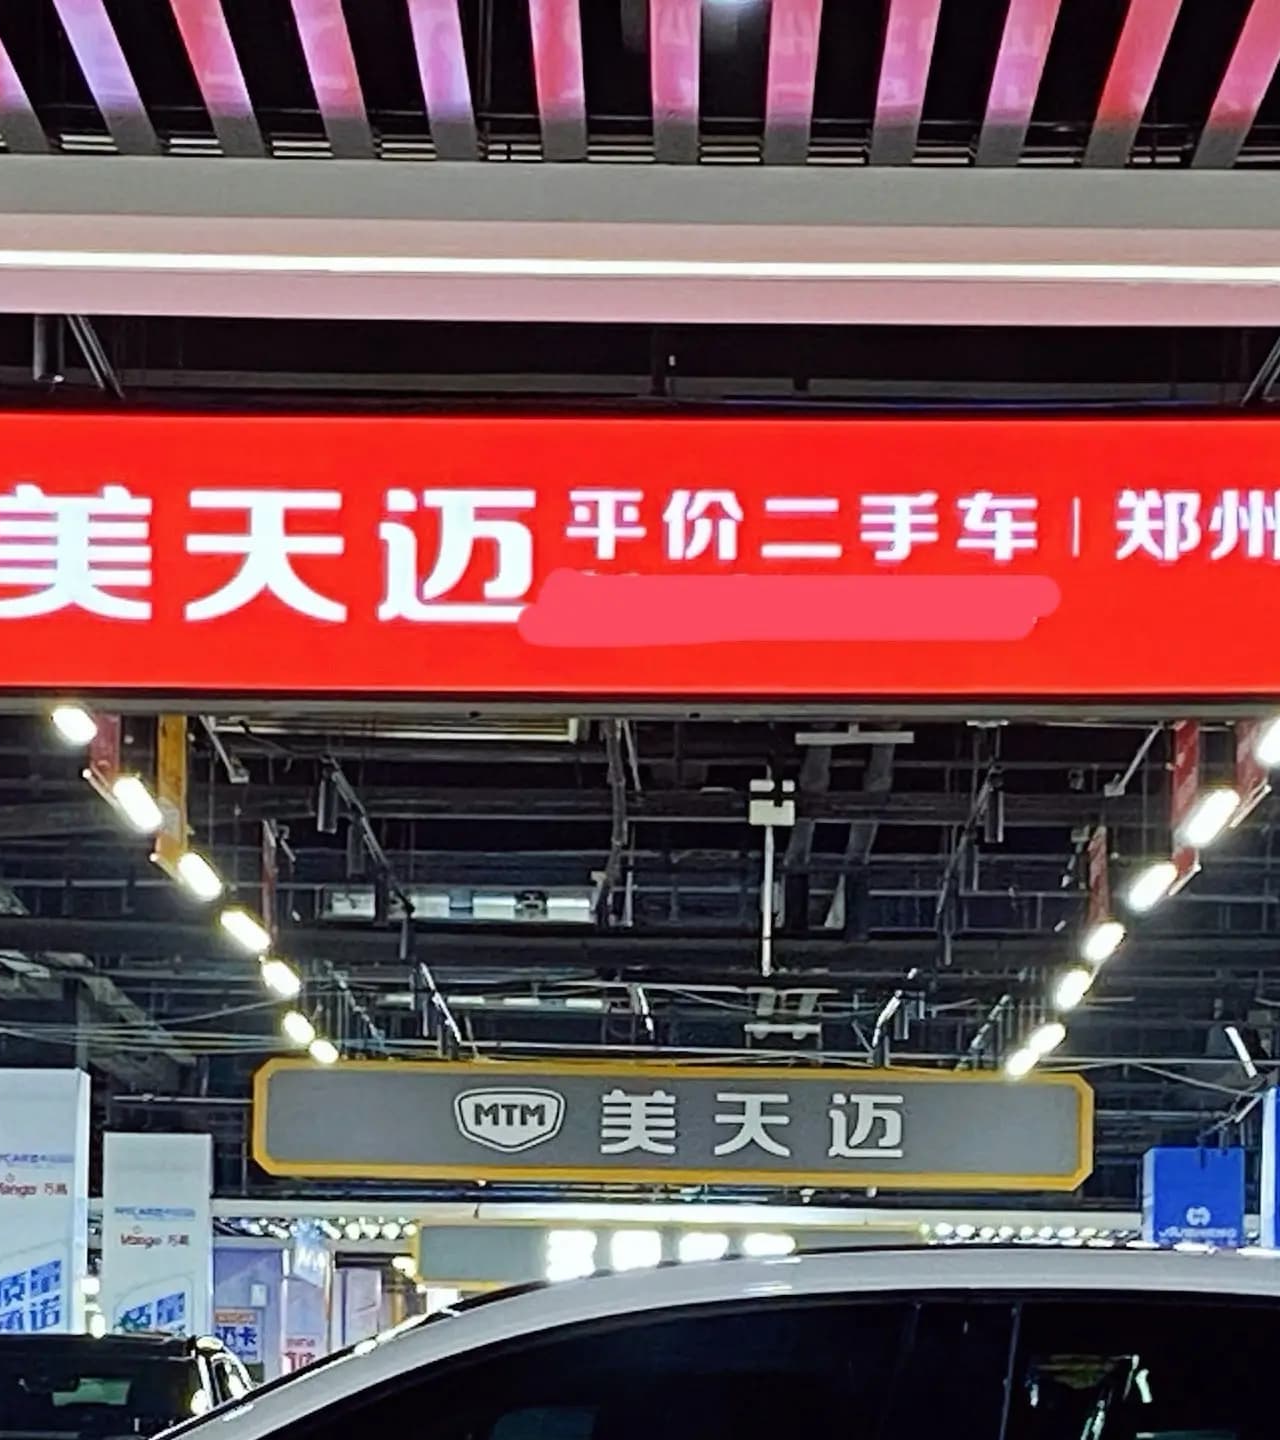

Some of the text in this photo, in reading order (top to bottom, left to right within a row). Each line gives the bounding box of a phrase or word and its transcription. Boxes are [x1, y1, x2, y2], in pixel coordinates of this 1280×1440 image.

[566, 489, 1039, 561] 平价二手车
[472, 1087, 905, 1158] MTM 美天迈
